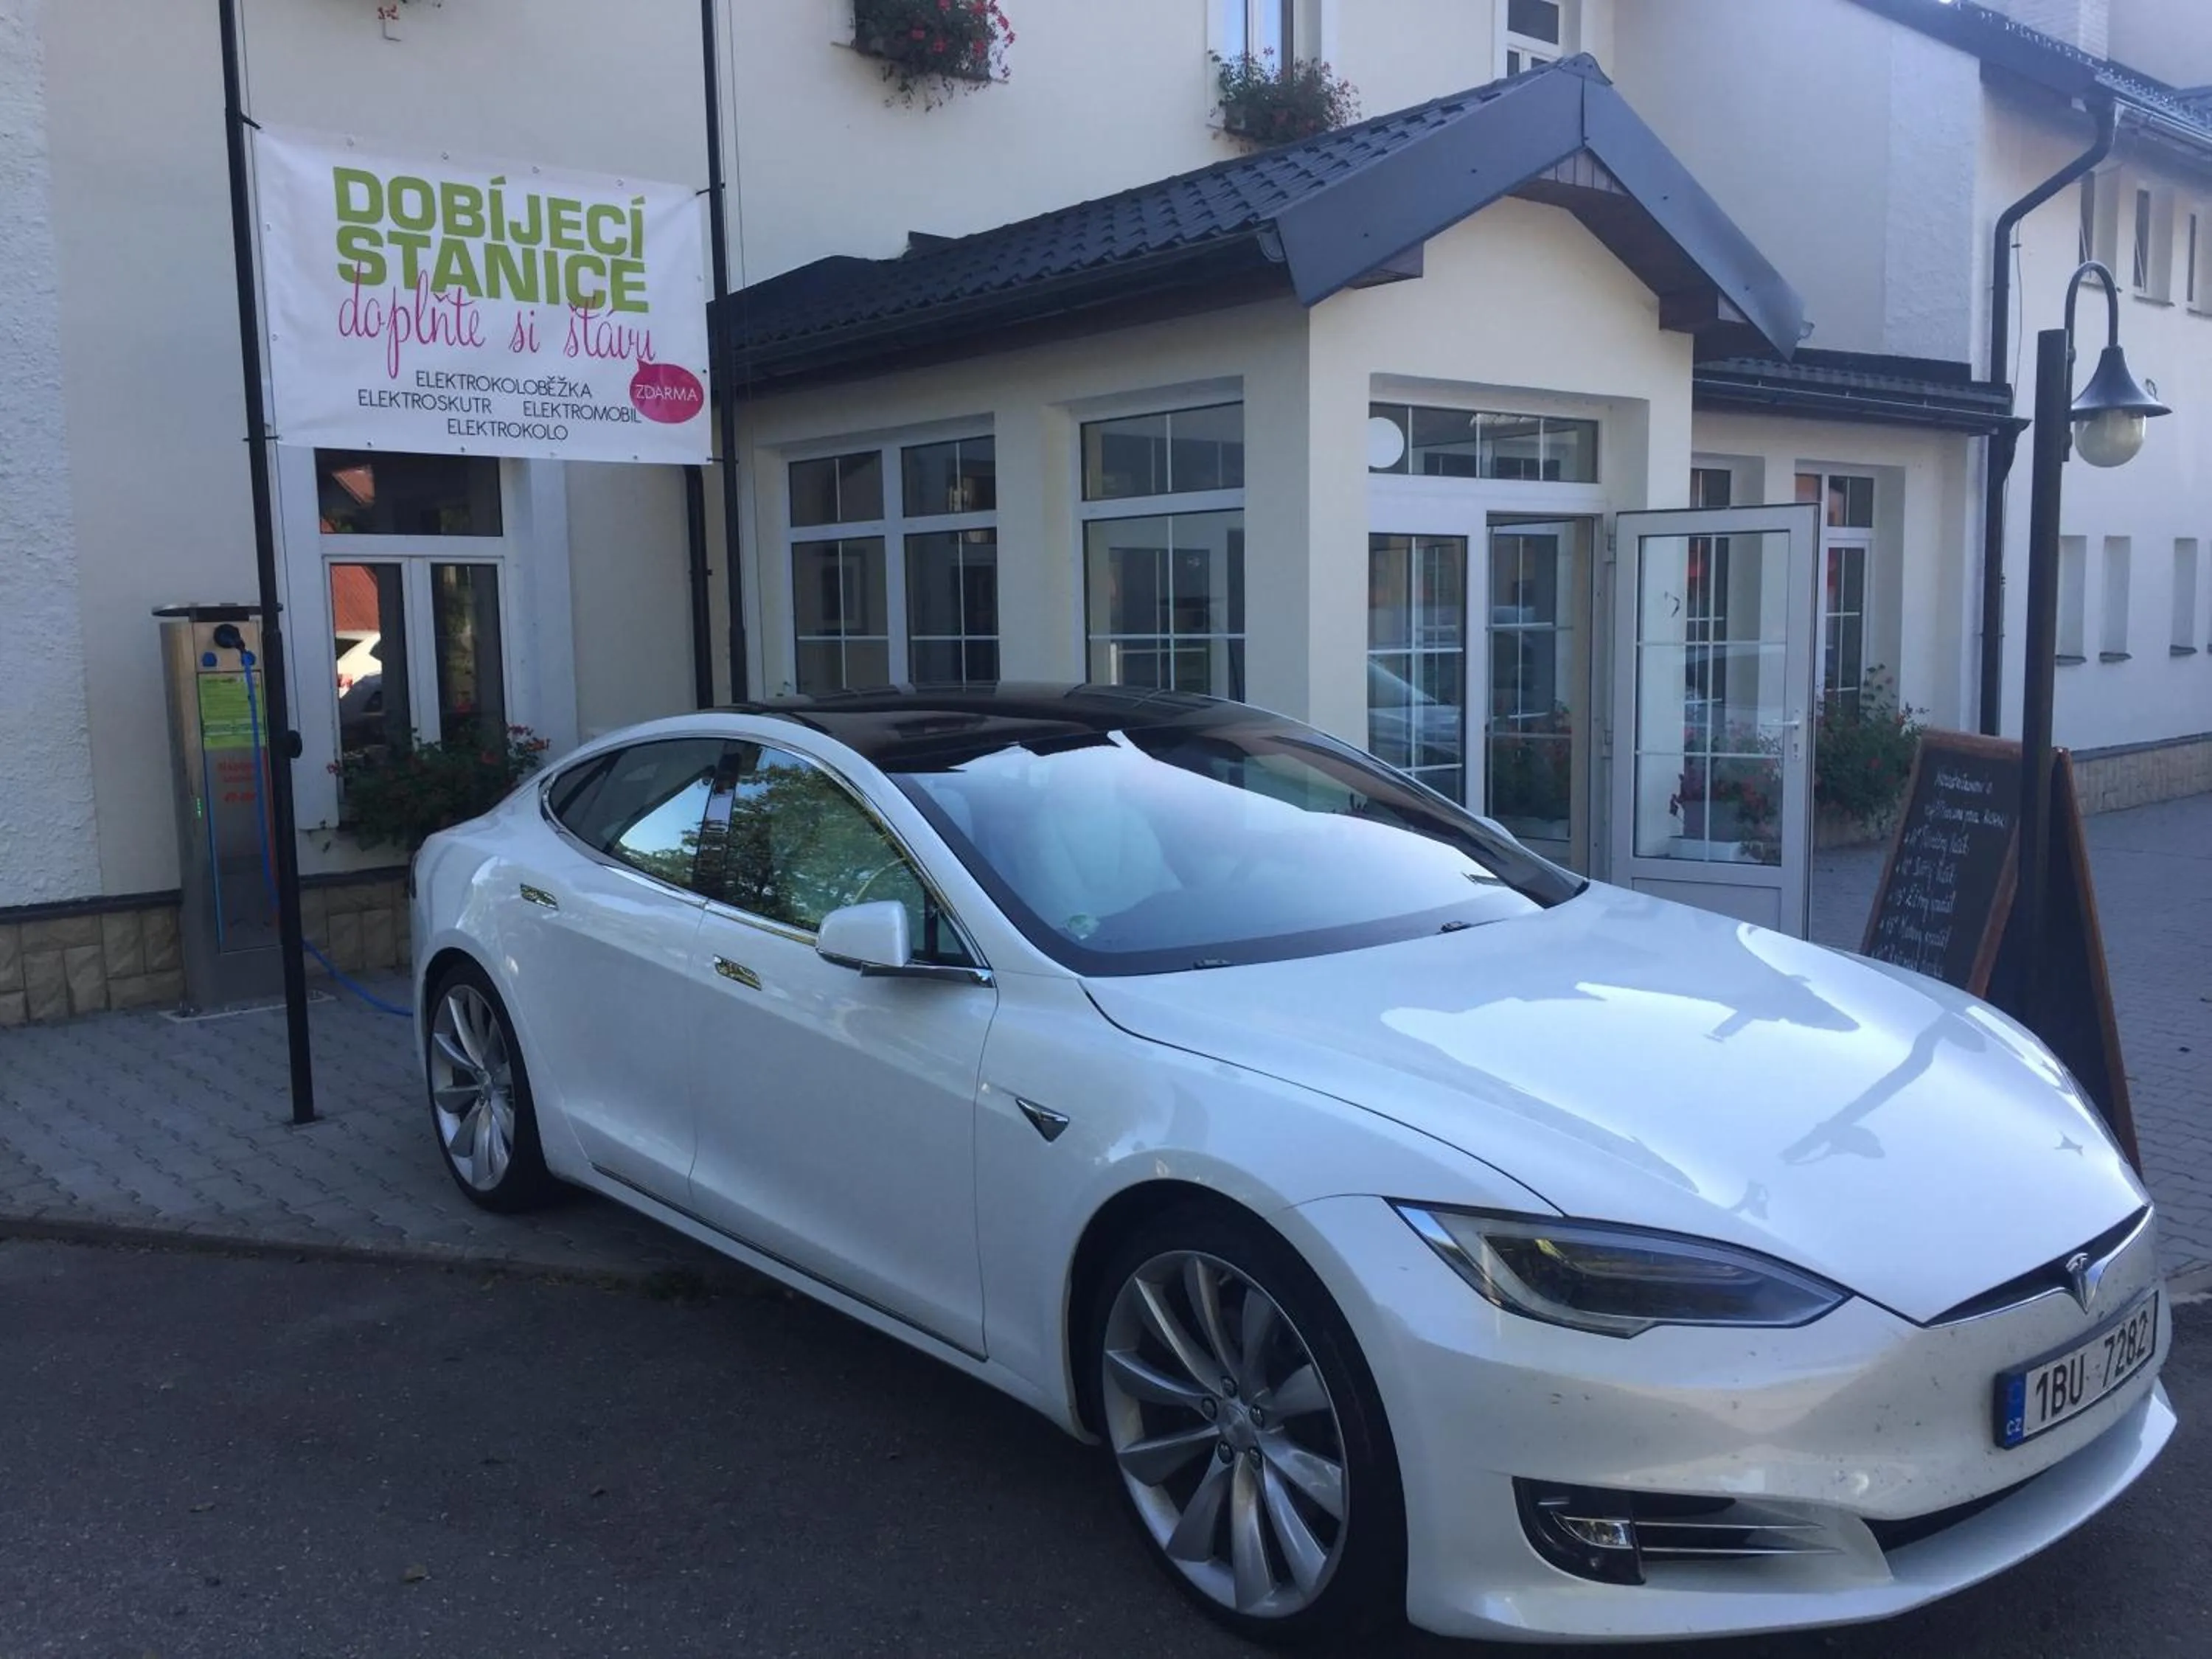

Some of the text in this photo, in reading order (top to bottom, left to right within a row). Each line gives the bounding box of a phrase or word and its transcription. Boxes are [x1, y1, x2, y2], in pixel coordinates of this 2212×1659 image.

[333, 166, 646, 259] DOBÍJECÍ
[335, 225, 650, 313] STANICE
[339, 260, 487, 379] doplňte
[509, 310, 540, 352] si
[416, 370, 593, 399] ELEKTROKOLOBĚŽKA
[636, 384, 699, 401] ZDARMA
[358, 389, 642, 423] ELEKTROSKUTR ELEKTROMOBIL
[448, 418, 568, 440] ELEKTROKOLO
[2036, 1310, 2149, 1422] 1BU 7282
[2006, 1417, 2022, 1436] CZ
